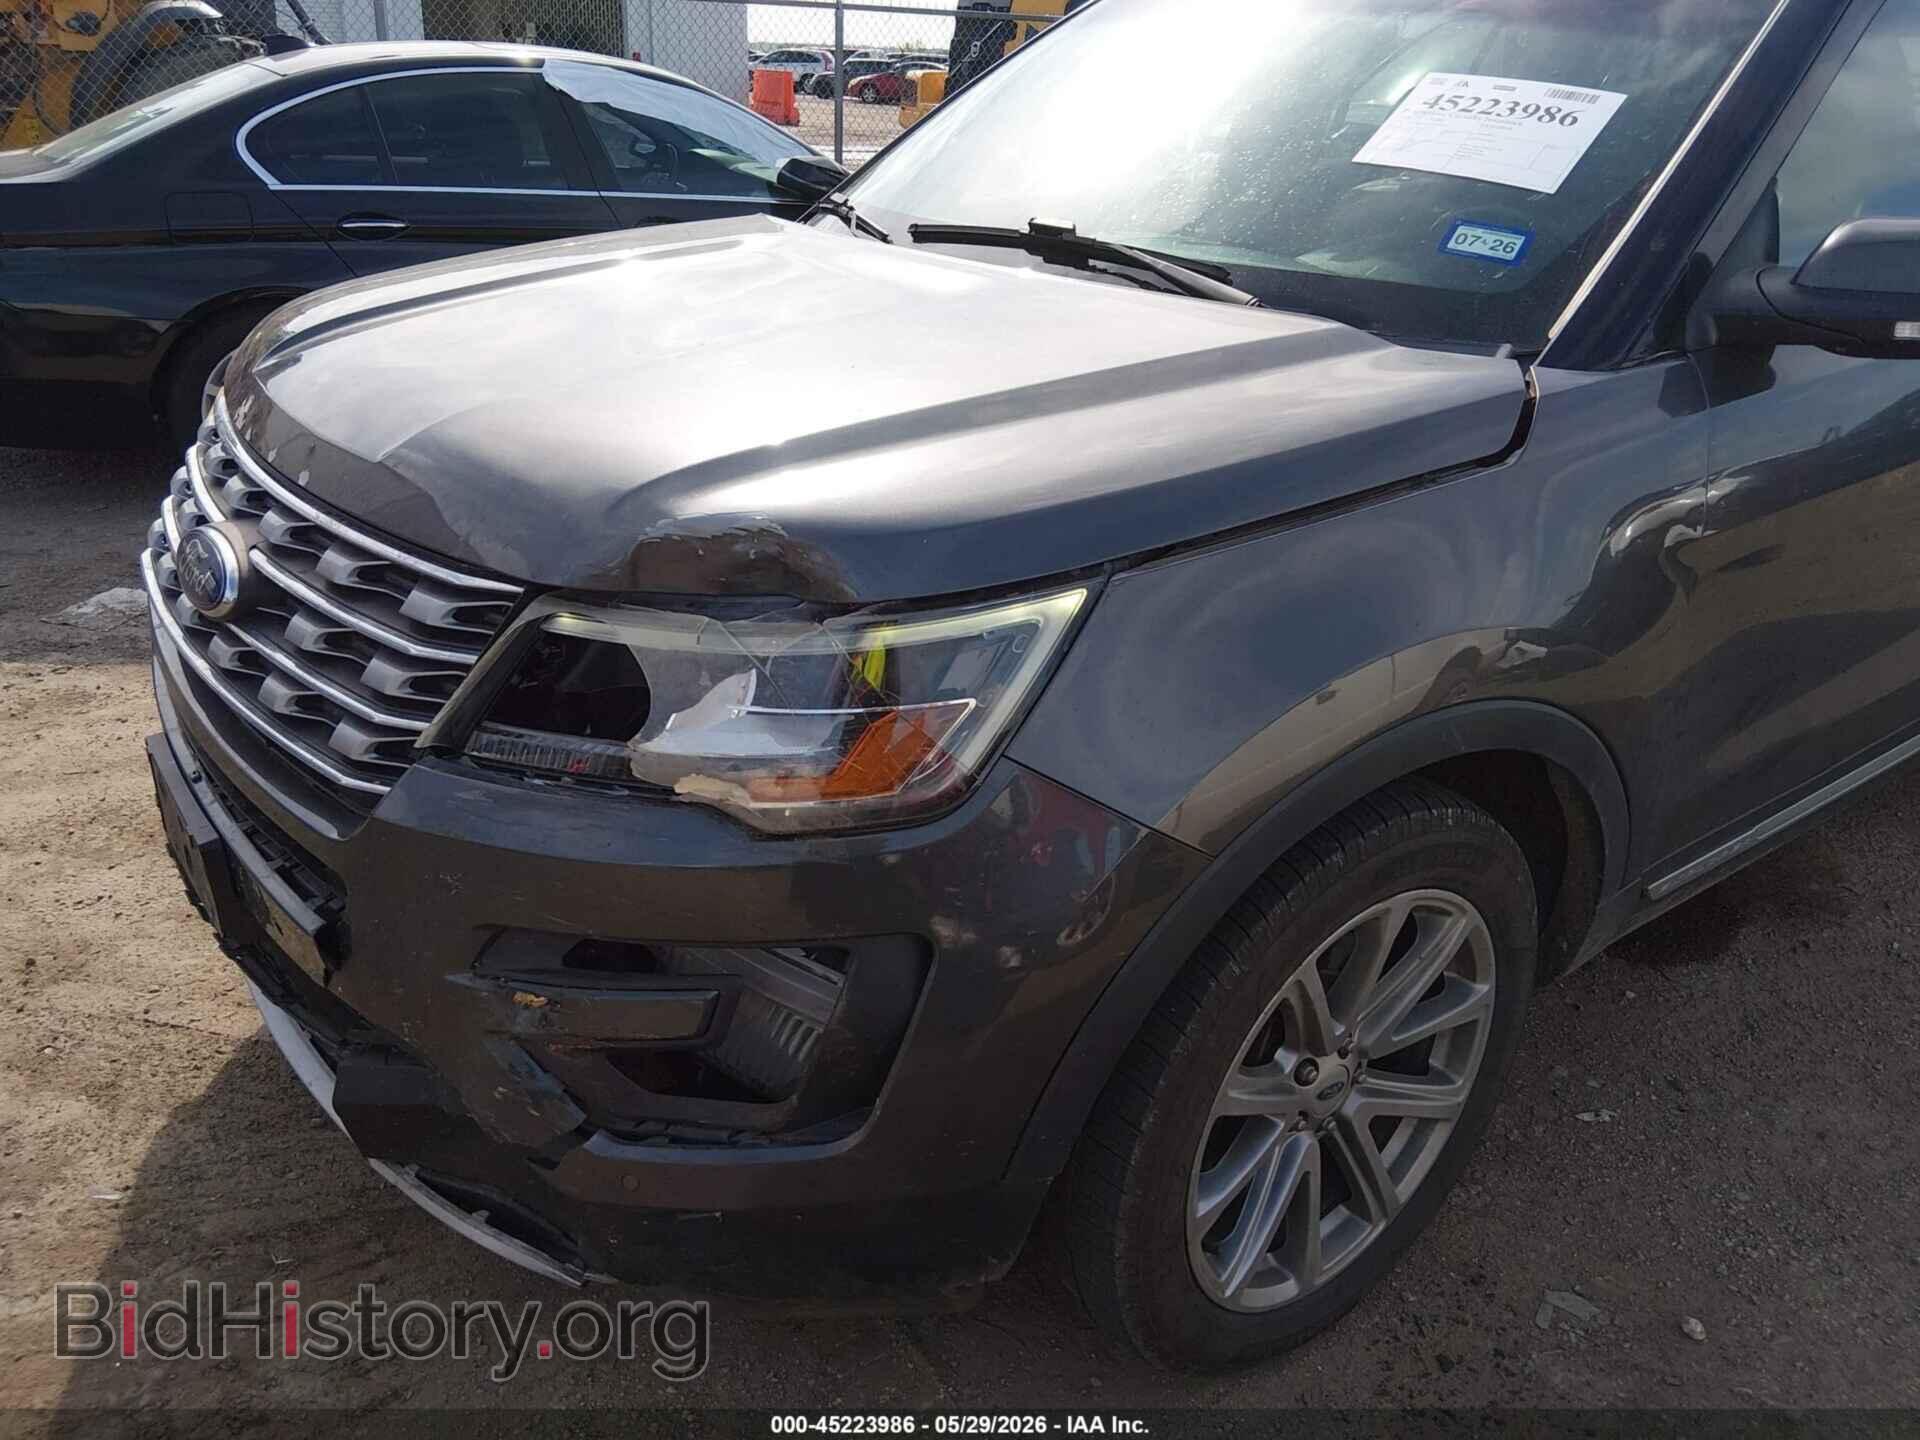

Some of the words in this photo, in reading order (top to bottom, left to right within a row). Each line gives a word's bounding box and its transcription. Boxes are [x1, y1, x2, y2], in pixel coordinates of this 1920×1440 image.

[1422, 94, 1587, 127] 45223986
[1454, 232, 1482, 247] 07
[1488, 239, 1517, 254] 26
